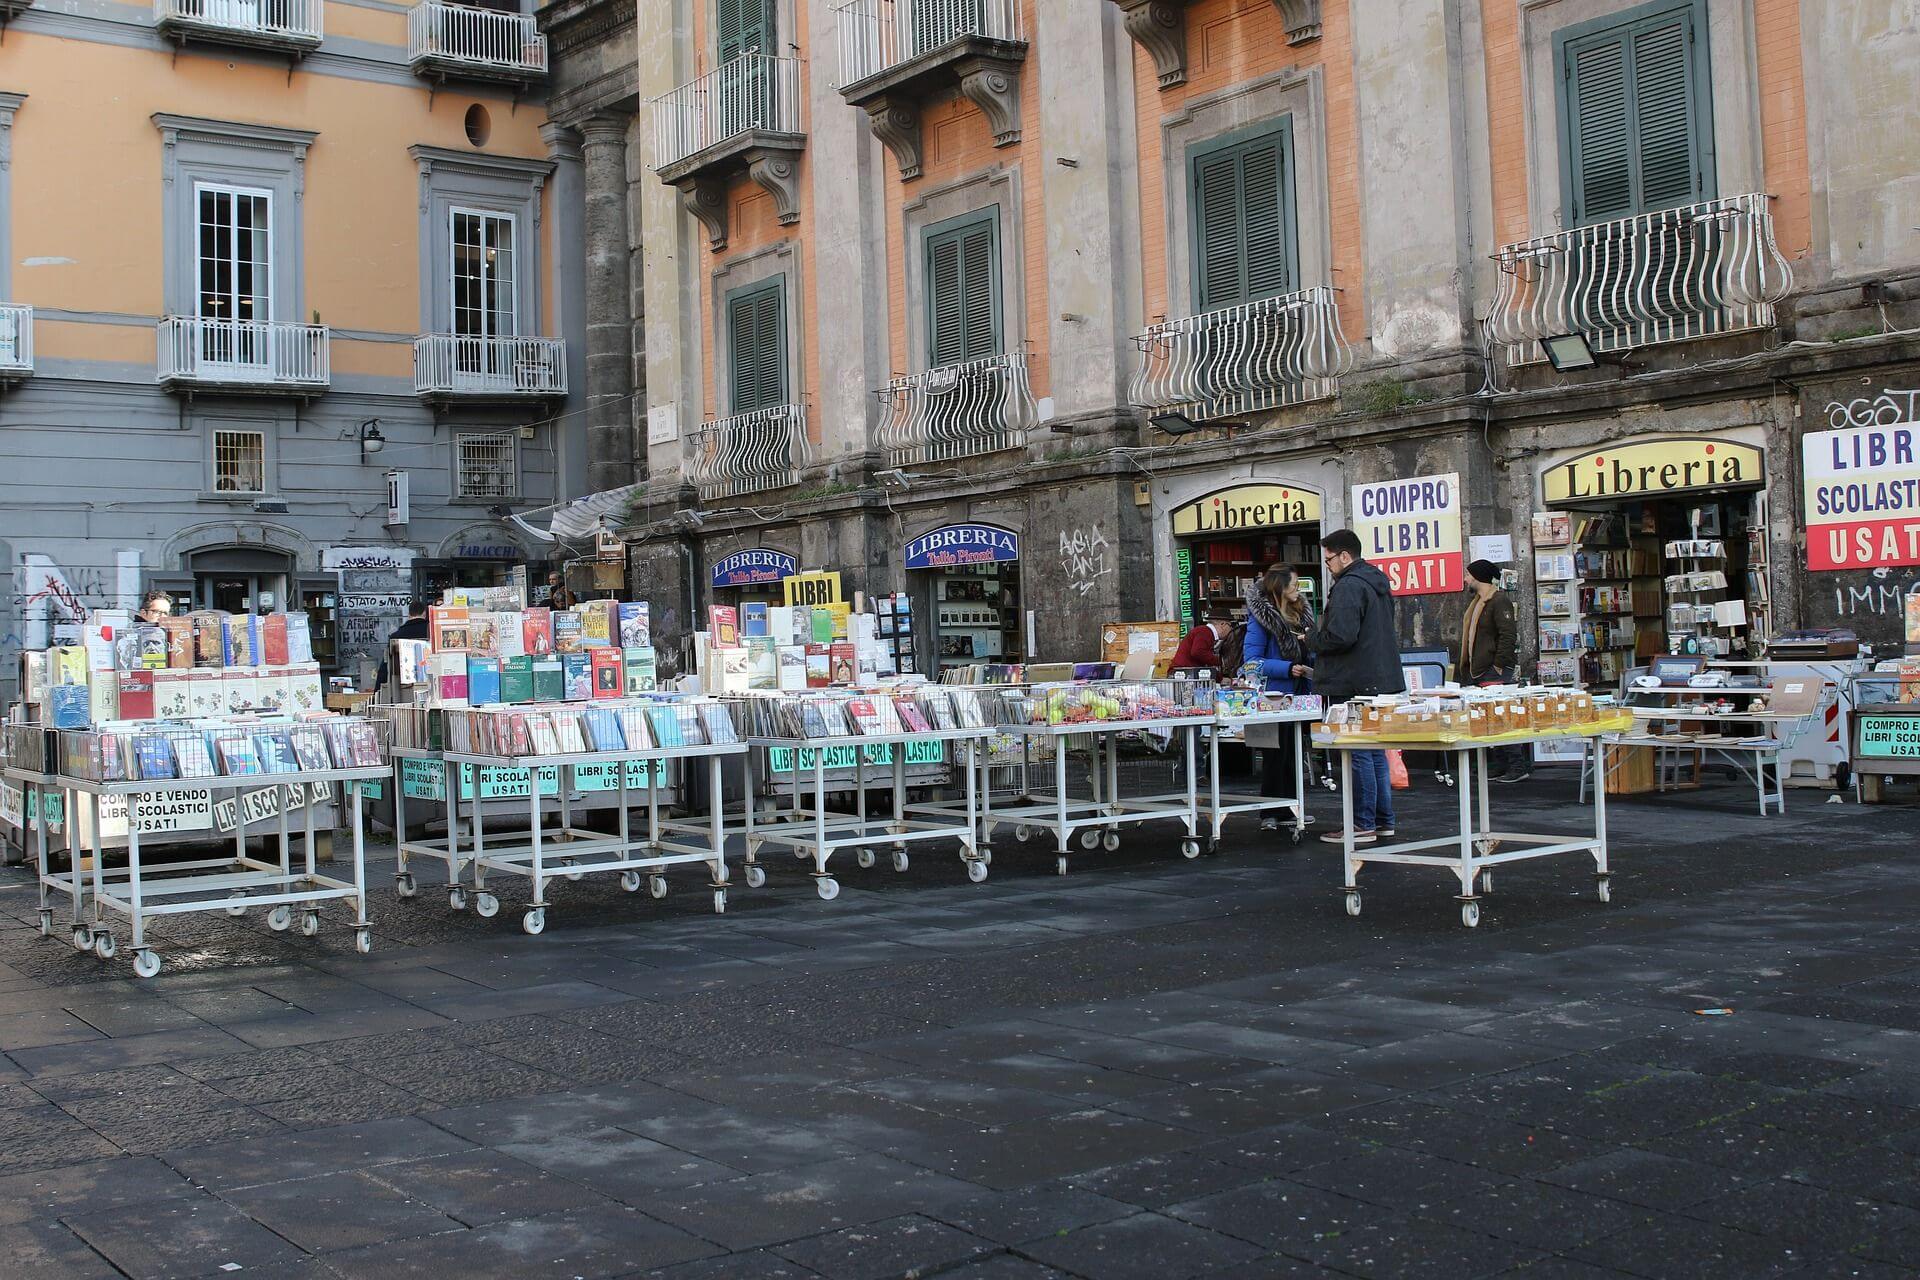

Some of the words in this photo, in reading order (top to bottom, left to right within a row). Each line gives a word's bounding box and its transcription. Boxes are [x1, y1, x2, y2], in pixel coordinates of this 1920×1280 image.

[1832, 430, 1913, 470] LIBR
[1565, 444, 1743, 498] Libreria
[1362, 480, 1448, 517] COMPRO
[1817, 479, 1920, 515] SCOLAST
[1193, 490, 1306, 531] Libreria
[908, 529, 1016, 560] LIBRERIA
[1374, 520, 1440, 554] LIBRI
[1829, 524, 1920, 564] USAT
[714, 552, 794, 578] LIBRERIA
[927, 551, 956, 566] Tullio
[348, 596, 377, 608] STATO
[791, 579, 834, 606] LIBRI
[1836, 578, 1920, 618] iMM
[1866, 720, 1909, 730] COMPRO
[1913, 722, 1919, 730] E
[1865, 732, 1891, 742] LIBRI
[774, 749, 795, 770] LIB
[802, 746, 857, 768] SCASTIC
[866, 744, 886, 762] IBRI
[889, 741, 941, 762] SLASTICI
[404, 760, 422, 770] COMPRO
[578, 766, 602, 776] LIBRI
[608, 764, 663, 775] SCLASTCI
[417, 774, 444, 786] SCOLASTCI
[465, 773, 491, 784] LRI
[496, 771, 556, 782] SCOLATICI
[604, 777, 638, 788] USTI
[100, 792, 151, 804] COMRO
[156, 792, 162, 801] E
[167, 790, 207, 801] VENDO
[253, 781, 328, 817] SCOASCI
[361, 786, 372, 796] SATI
[416, 785, 432, 796] USATI
[492, 785, 528, 795] USATI
[100, 808, 128, 818] LIBR
[138, 803, 208, 816] SCOLASTICI
